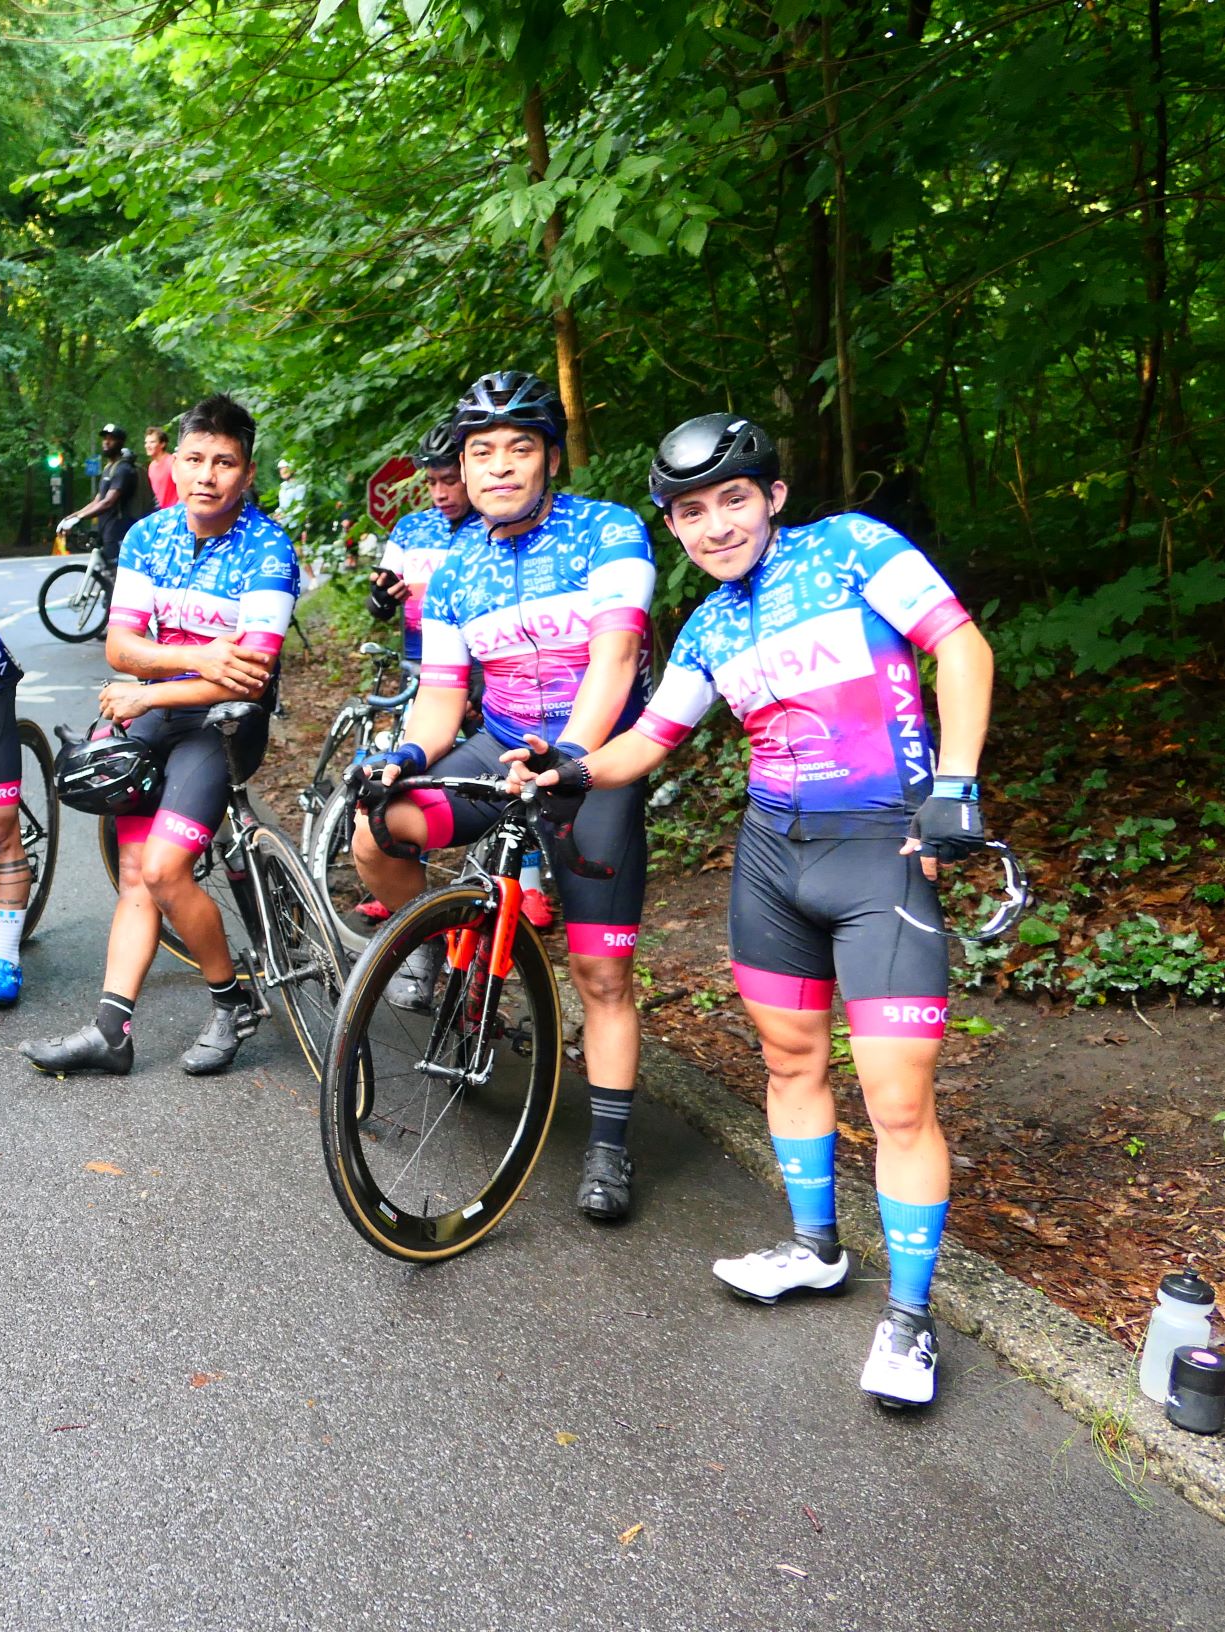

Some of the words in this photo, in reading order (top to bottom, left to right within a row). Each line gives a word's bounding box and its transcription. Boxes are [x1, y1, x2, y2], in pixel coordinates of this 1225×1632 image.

[473, 608, 590, 655] SANBA
[723, 640, 841, 709] SANBA
[887, 663, 928, 785] SANBA
